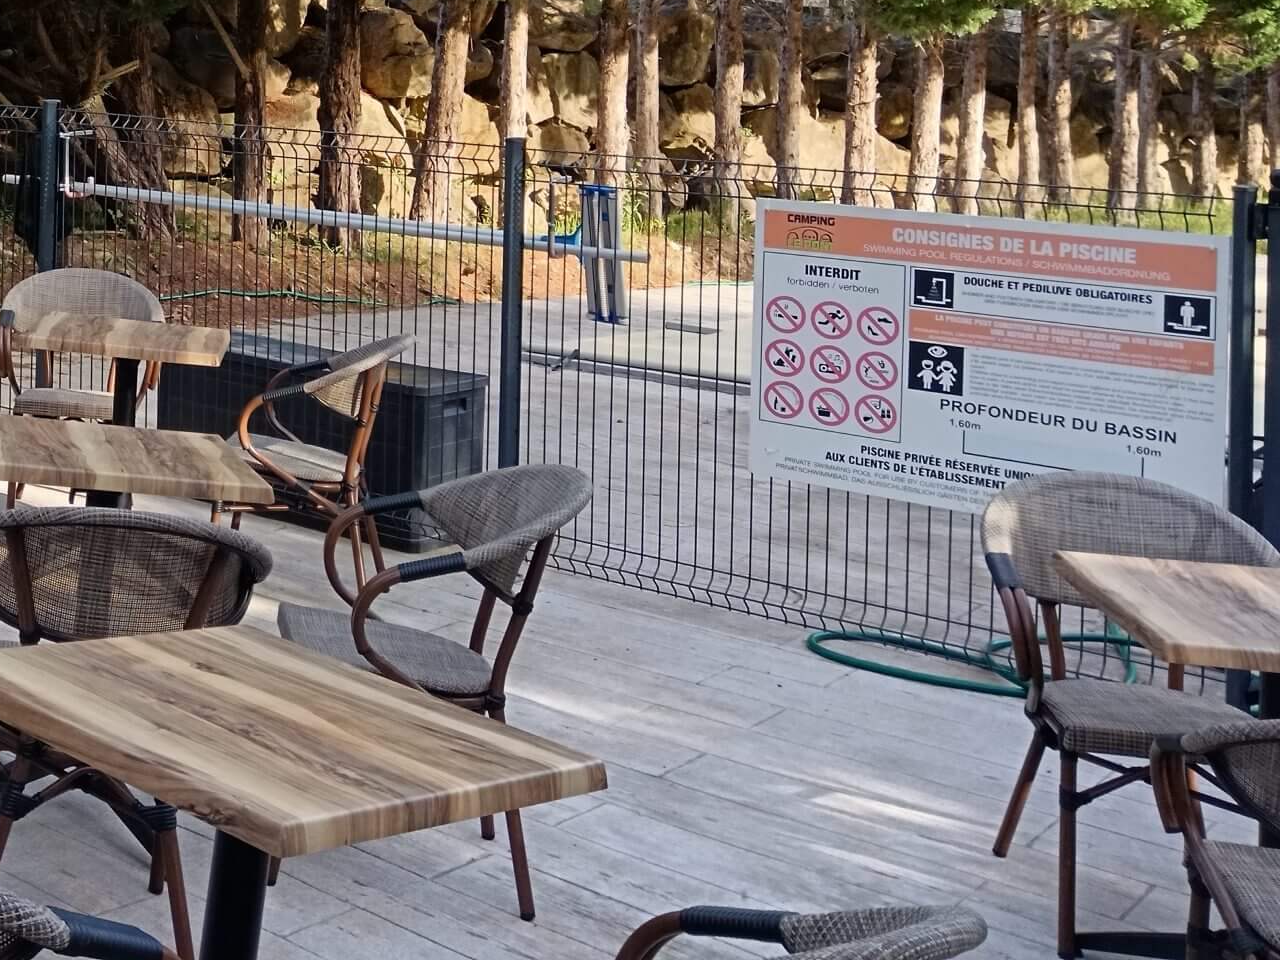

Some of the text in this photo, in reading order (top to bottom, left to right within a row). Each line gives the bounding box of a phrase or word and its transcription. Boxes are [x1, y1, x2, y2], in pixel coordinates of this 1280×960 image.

[787, 213, 836, 227] CAMPING
[891, 227, 1137, 265] CONSIGNES DE LA PISCINE
[804, 264, 862, 281] INTERDIT
[863, 243, 917, 258] SWIMMING
[919, 248, 947, 261] POOL
[949, 251, 1023, 268] REGULATIONS
[1031, 259, 1171, 282] SCHWIMMBADORDNUNG
[787, 276, 830, 289] forbidden
[838, 283, 880, 295] verboten
[963, 276, 1004, 289] DOUCHE
[1007, 280, 1020, 290] ET
[1022, 283, 1072, 297] PEDILUVE
[1075, 287, 1153, 305] OBLIGATOIRES
[939, 398, 1177, 444] PROFONDEUR DU BASSIN
[784, 456, 811, 466] PRIVATE
[825, 451, 1007, 490] AUX CLIENTS DE L'ÉTABLISSEMENT
[860, 445, 900, 460] PISCINE
[904, 451, 945, 467] PRIVÉE
[945, 458, 1001, 477] RÉSERVÉE
